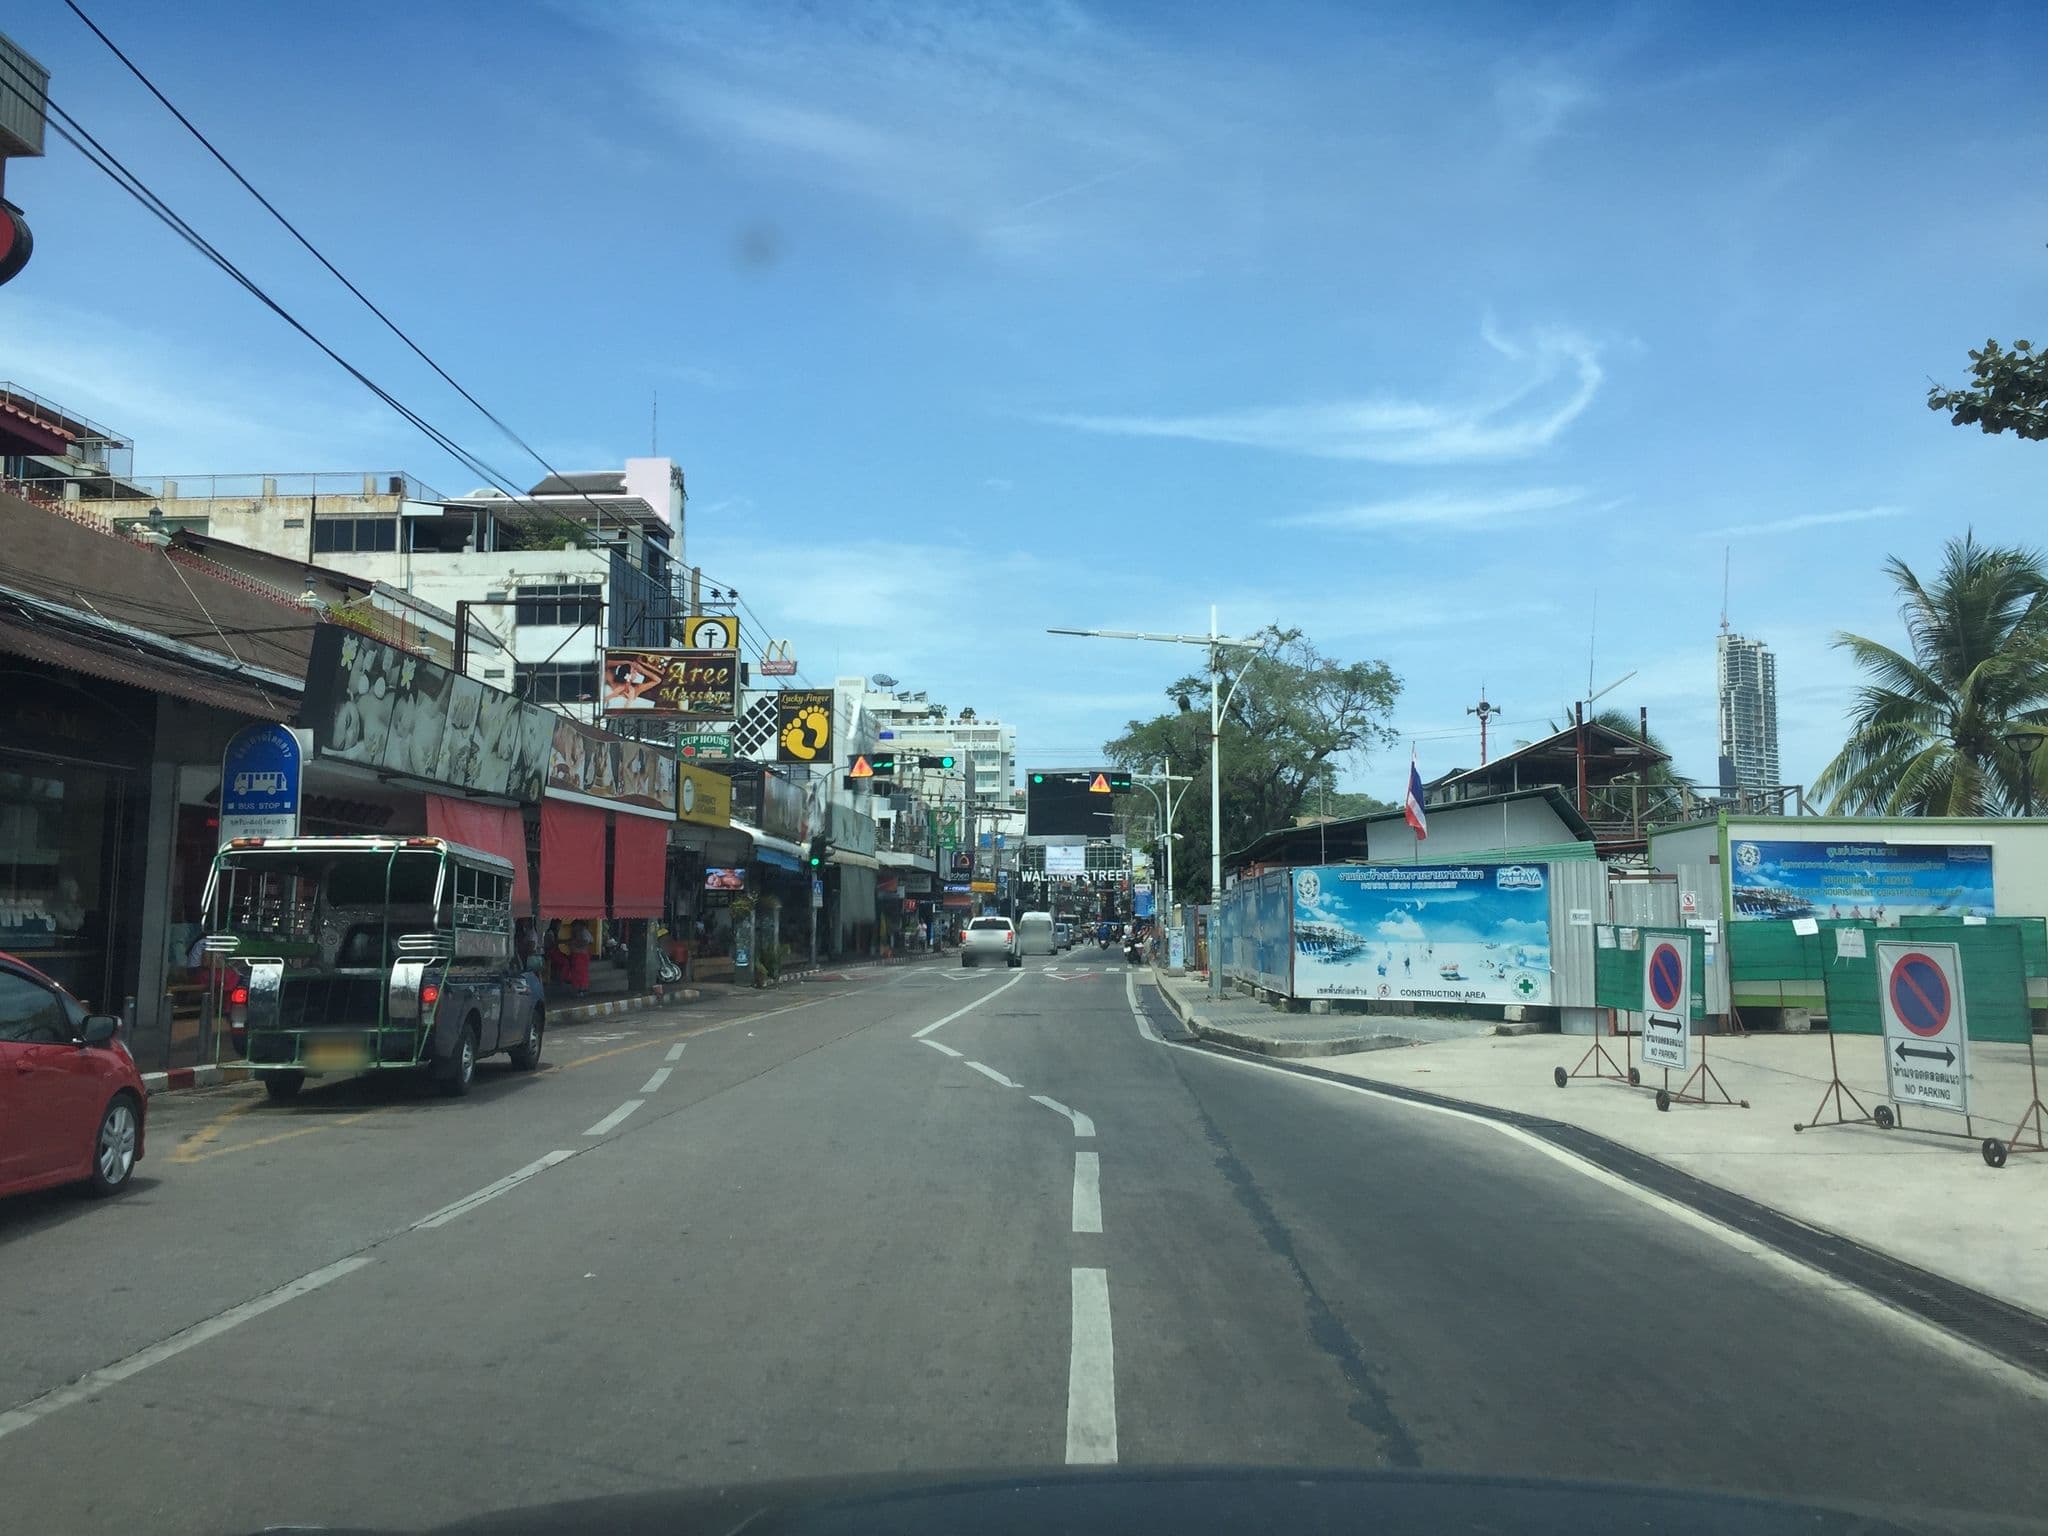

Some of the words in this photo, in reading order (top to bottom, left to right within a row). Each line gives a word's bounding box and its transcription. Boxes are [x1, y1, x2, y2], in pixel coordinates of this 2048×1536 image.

[668, 662, 729, 685] Aree
[660, 685, 731, 704] Massage
[781, 694, 804, 705] Lucky
[804, 693, 830, 705] Finger
[681, 735, 699, 747] CUP
[700, 735, 730, 747] HOUSE
[259, 802, 281, 810] STOP
[1082, 869, 1131, 882] STREET
[1400, 988, 1461, 998] CONSTRUCTION
[1465, 990, 1486, 999] AREA
[1905, 1084, 1916, 1095] NO
[1919, 1086, 1951, 1100] PARKING
